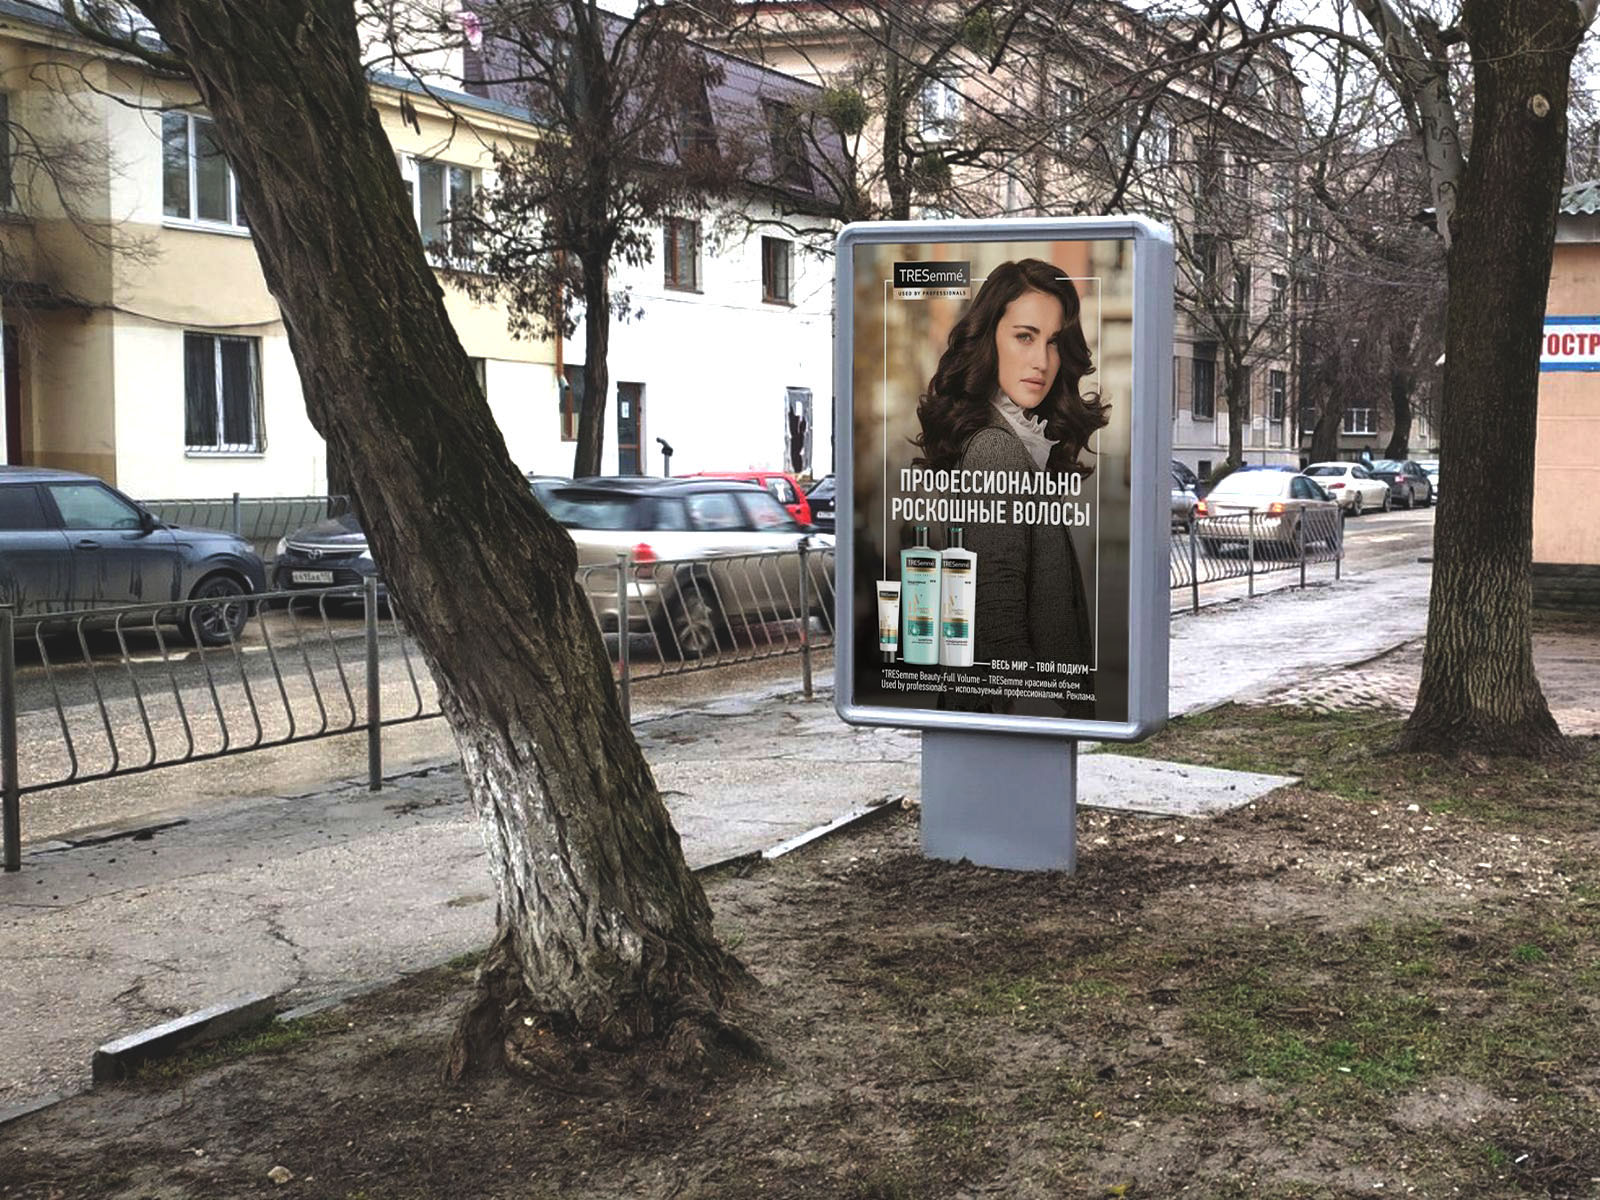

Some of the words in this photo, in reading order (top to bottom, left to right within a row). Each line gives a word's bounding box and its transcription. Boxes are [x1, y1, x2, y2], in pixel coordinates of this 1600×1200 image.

[1543, 333, 1600, 355] ОСТР
[900, 469, 1081, 496] ПРОФЕССИОНАЛЬНО
[892, 498, 1007, 524] РОСКОШНЫЕ
[1013, 501, 1090, 527] ВОЛОСЫ
[991, 660, 1010, 670] ВЕСЬ
[1011, 661, 1028, 671] МИР
[1036, 661, 1055, 673] ТВОЙ
[1057, 663, 1089, 675] ПОДИУМ
[881, 680, 897, 689] Used
[898, 680, 905, 691] by
[906, 682, 947, 692] professionals
[955, 686, 1003, 696] используемый
[957, 673, 980, 684] Volume
[1024, 679, 1057, 688] красивый
